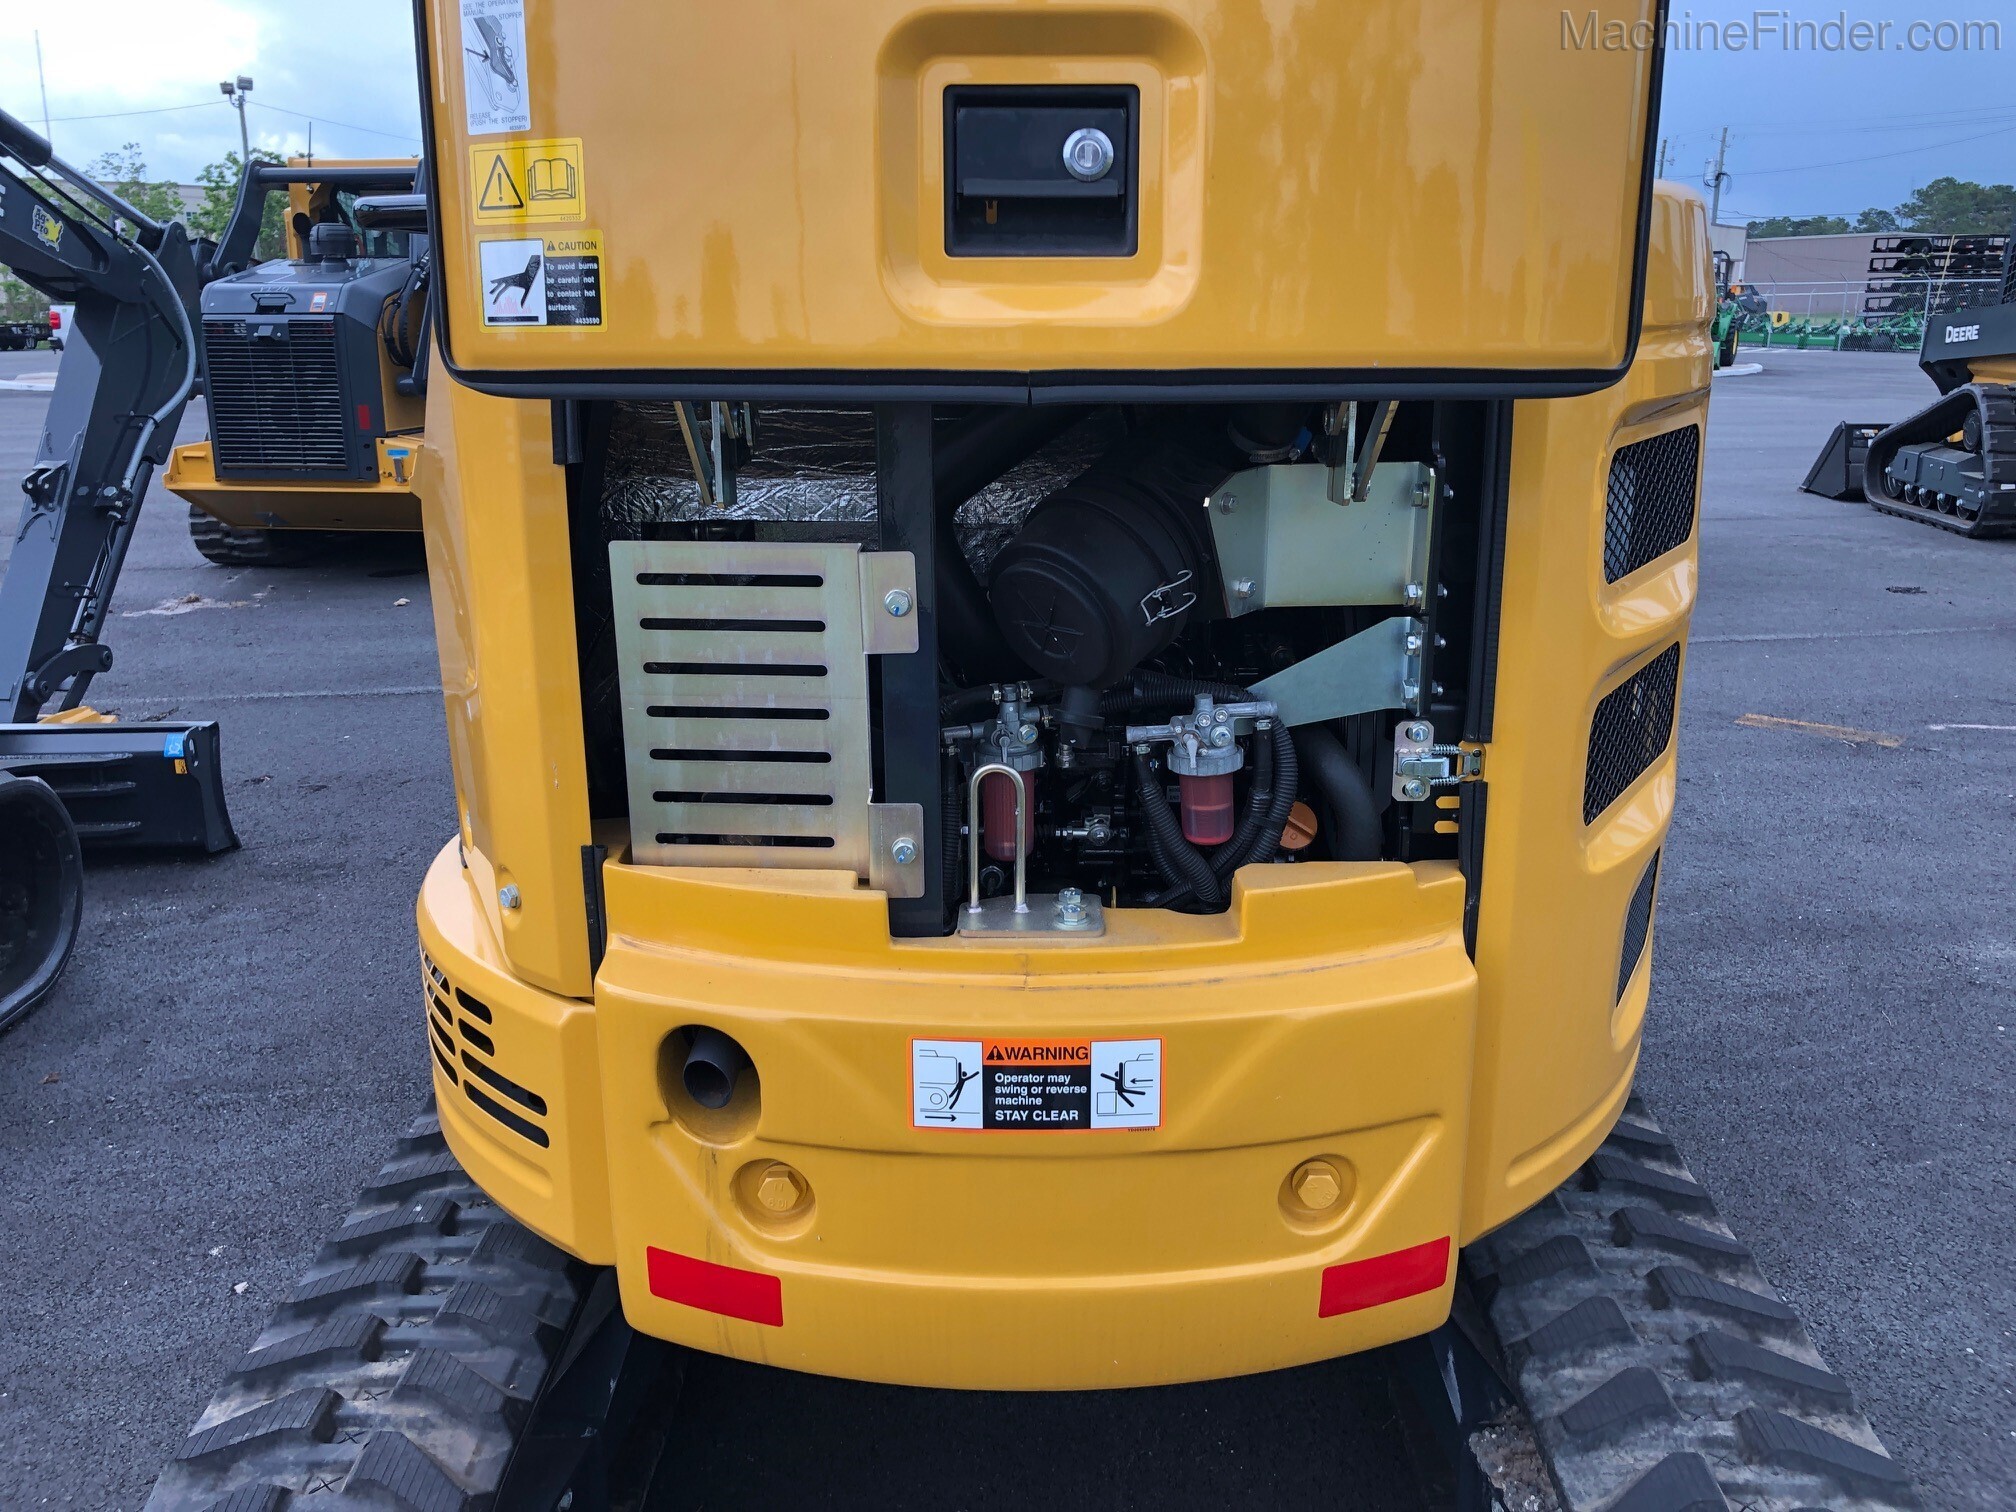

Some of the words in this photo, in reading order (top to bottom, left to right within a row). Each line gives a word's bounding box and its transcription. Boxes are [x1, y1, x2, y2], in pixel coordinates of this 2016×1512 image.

[498, 11, 522, 20] STOPPER
[470, 112, 491, 120] RELEASE
[501, 115, 527, 124] STOPPER)
[558, 240, 597, 251] CAUTION
[558, 262, 575, 270] avoid
[578, 262, 598, 270] burns
[546, 276, 555, 284] be
[557, 276, 580, 284] careful
[557, 290, 581, 298] contact
[548, 303, 577, 311] surfaces.
[1945, 324, 1980, 344] DEERE
[1005, 1046, 1089, 1060] WARNING
[995, 1073, 1045, 1085] Operator
[1047, 1074, 1071, 1085] may
[995, 1084, 1028, 1095] swing
[1031, 1086, 1043, 1094] or
[1046, 1085, 1088, 1094] reverse
[995, 1095, 1043, 1105] machine
[995, 1110, 1029, 1121] STAY
[1032, 1110, 1079, 1121] CLEAR
